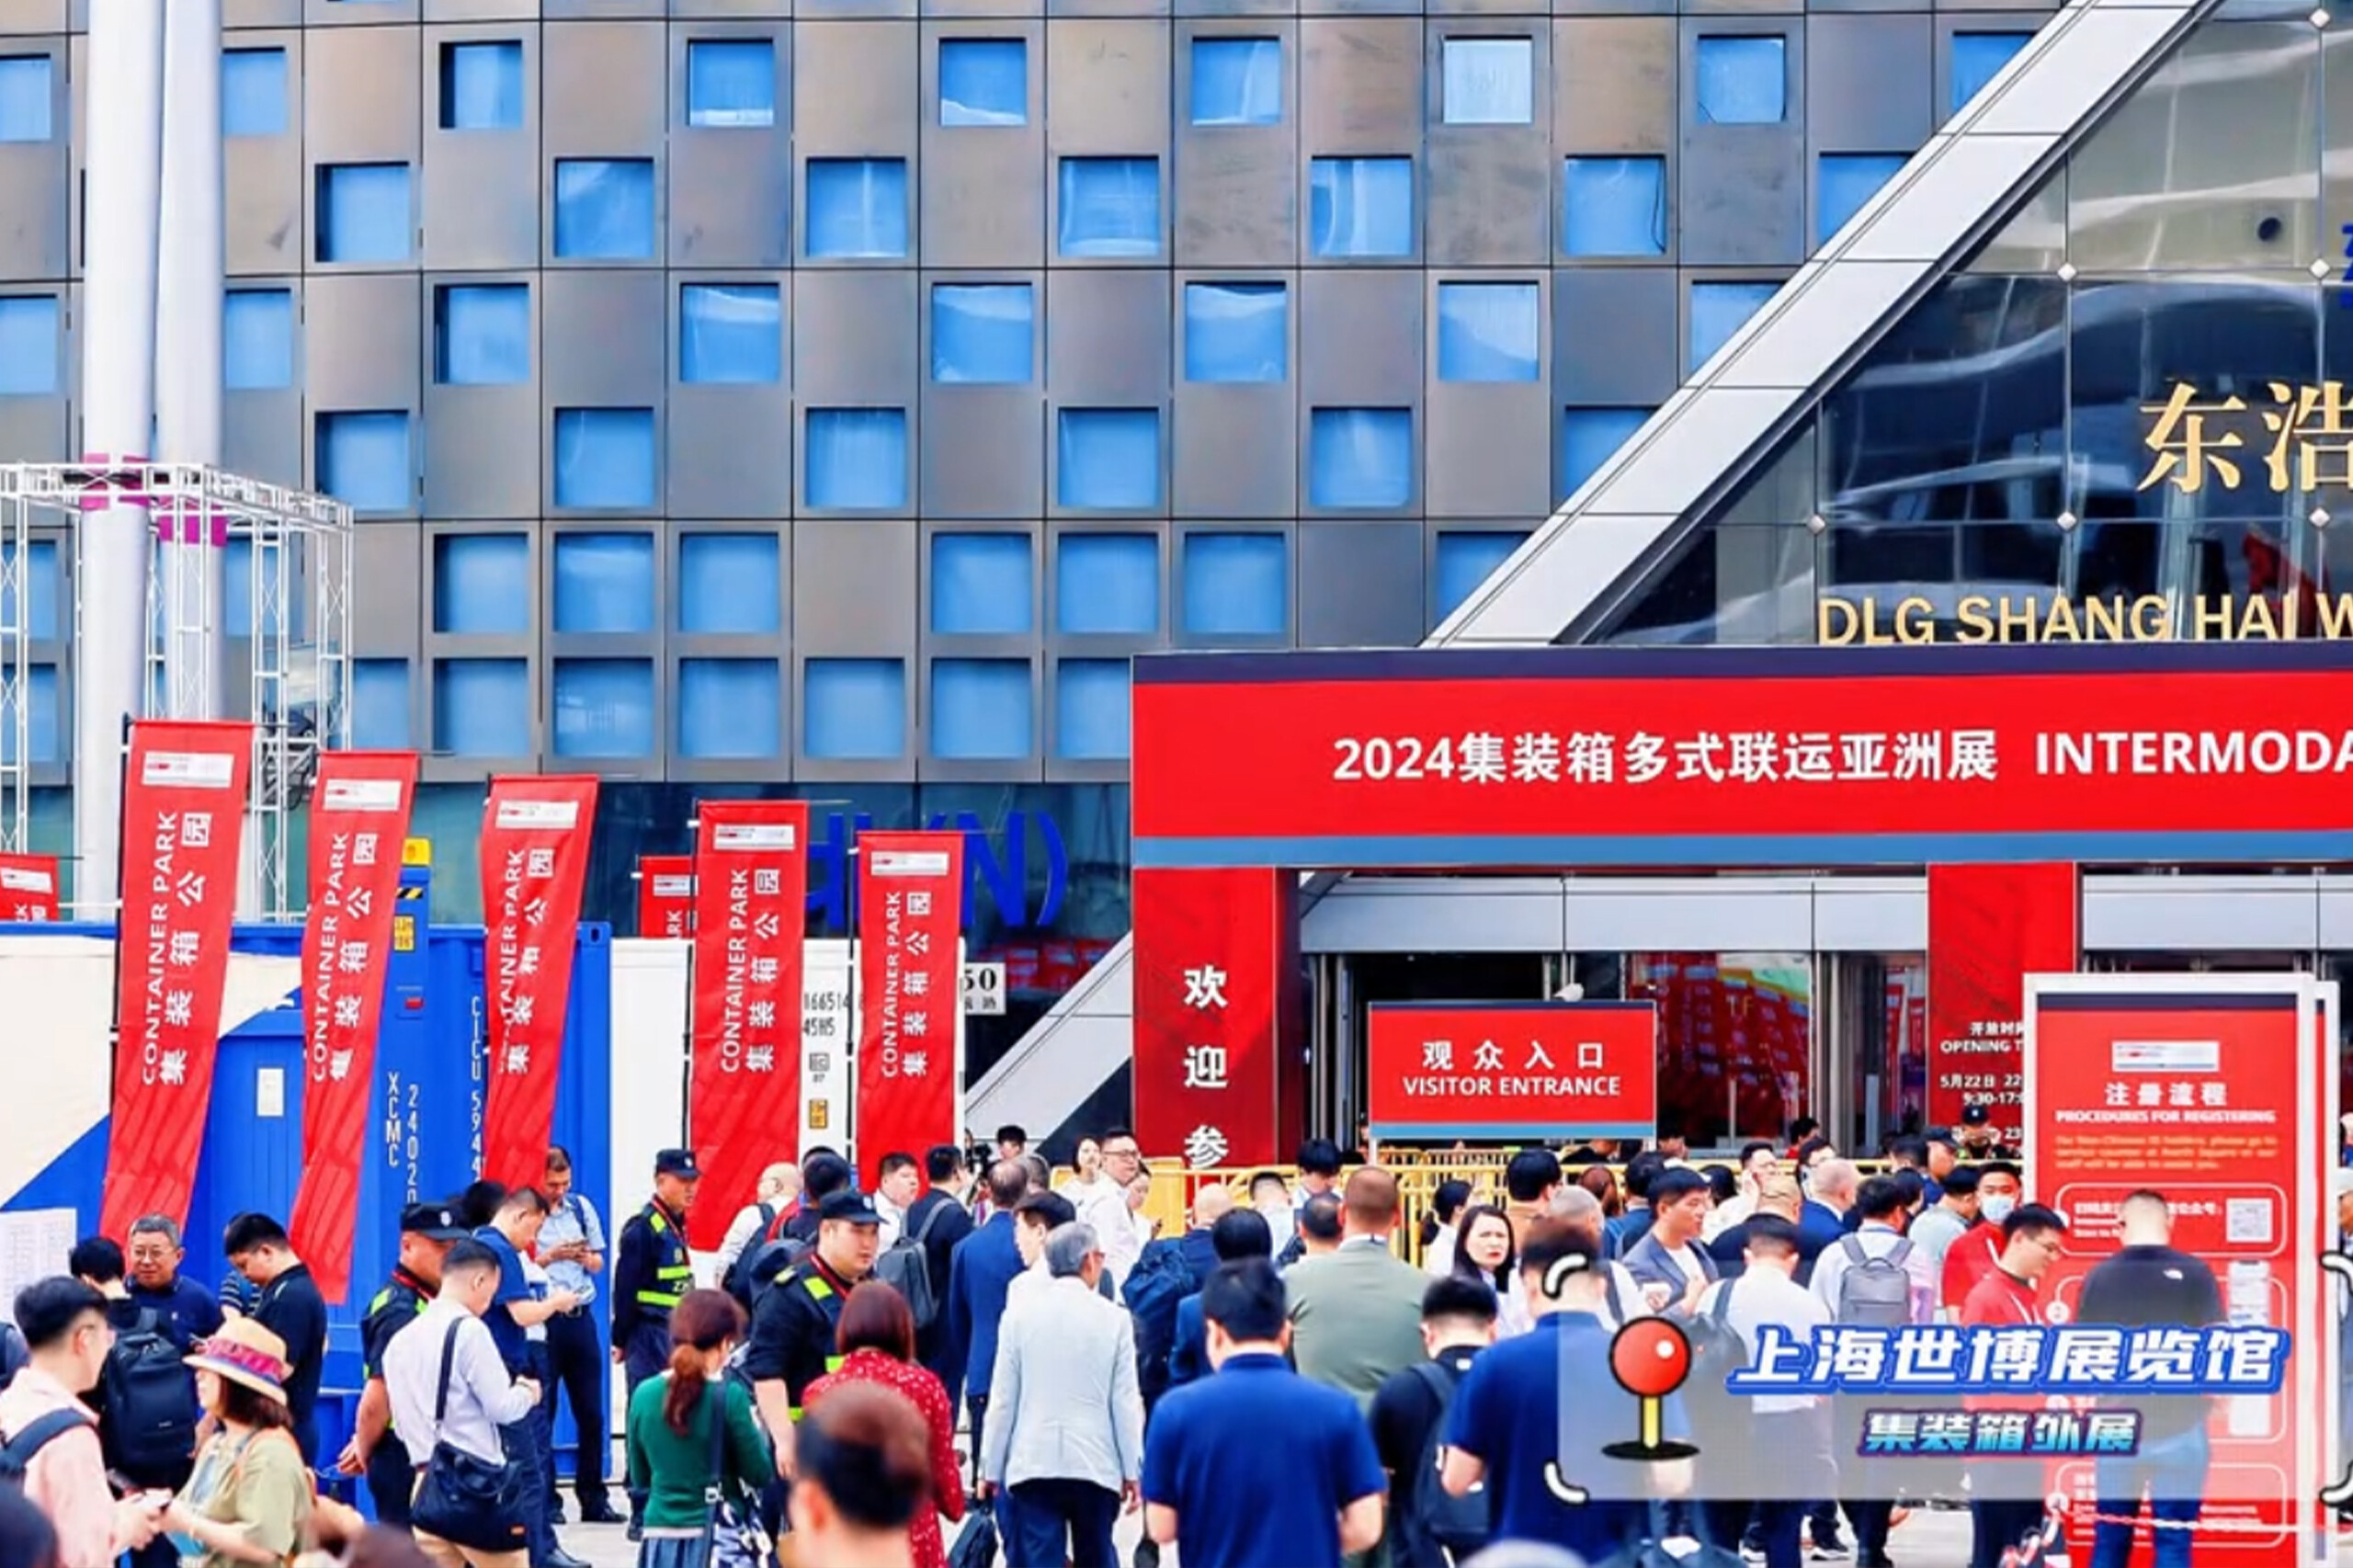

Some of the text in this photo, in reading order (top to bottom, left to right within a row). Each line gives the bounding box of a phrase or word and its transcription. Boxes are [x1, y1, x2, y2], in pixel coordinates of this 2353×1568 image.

[2137, 382, 2353, 494] 东浩
[1818, 596, 1934, 644] DLG
[1956, 594, 2168, 643] SHANG
[2194, 594, 2297, 641] HAI
[1333, 730, 1997, 784] 2024集装箱多式联运亚洲展
[142, 812, 177, 1085] CONTAINER PARK
[159, 812, 212, 1085] 集装箱公园
[313, 833, 348, 1082] CONTAINER PARK
[499, 849, 525, 1074] TAINER PARK
[721, 869, 748, 1073] CONTAINER PARK
[745, 869, 779, 1072] 集装箱公园
[882, 892, 902, 1078] CONTAINER PARK
[903, 892, 931, 1077] 集装箱公园
[385, 1071, 401, 1167] XCMC
[471, 995, 482, 1182] CICU 5944
[1184, 964, 1230, 1169] 欢迎参
[1404, 1075, 1620, 1097] VISITOR ENTRANCE
[1422, 1040, 1605, 1071] 观众入口
[1939, 1040, 2011, 1053] OPENING
[2055, 1109, 2277, 1123] PROCEDURES FOR REGISTERING
[2106, 1082, 2228, 1106] 注册流程
